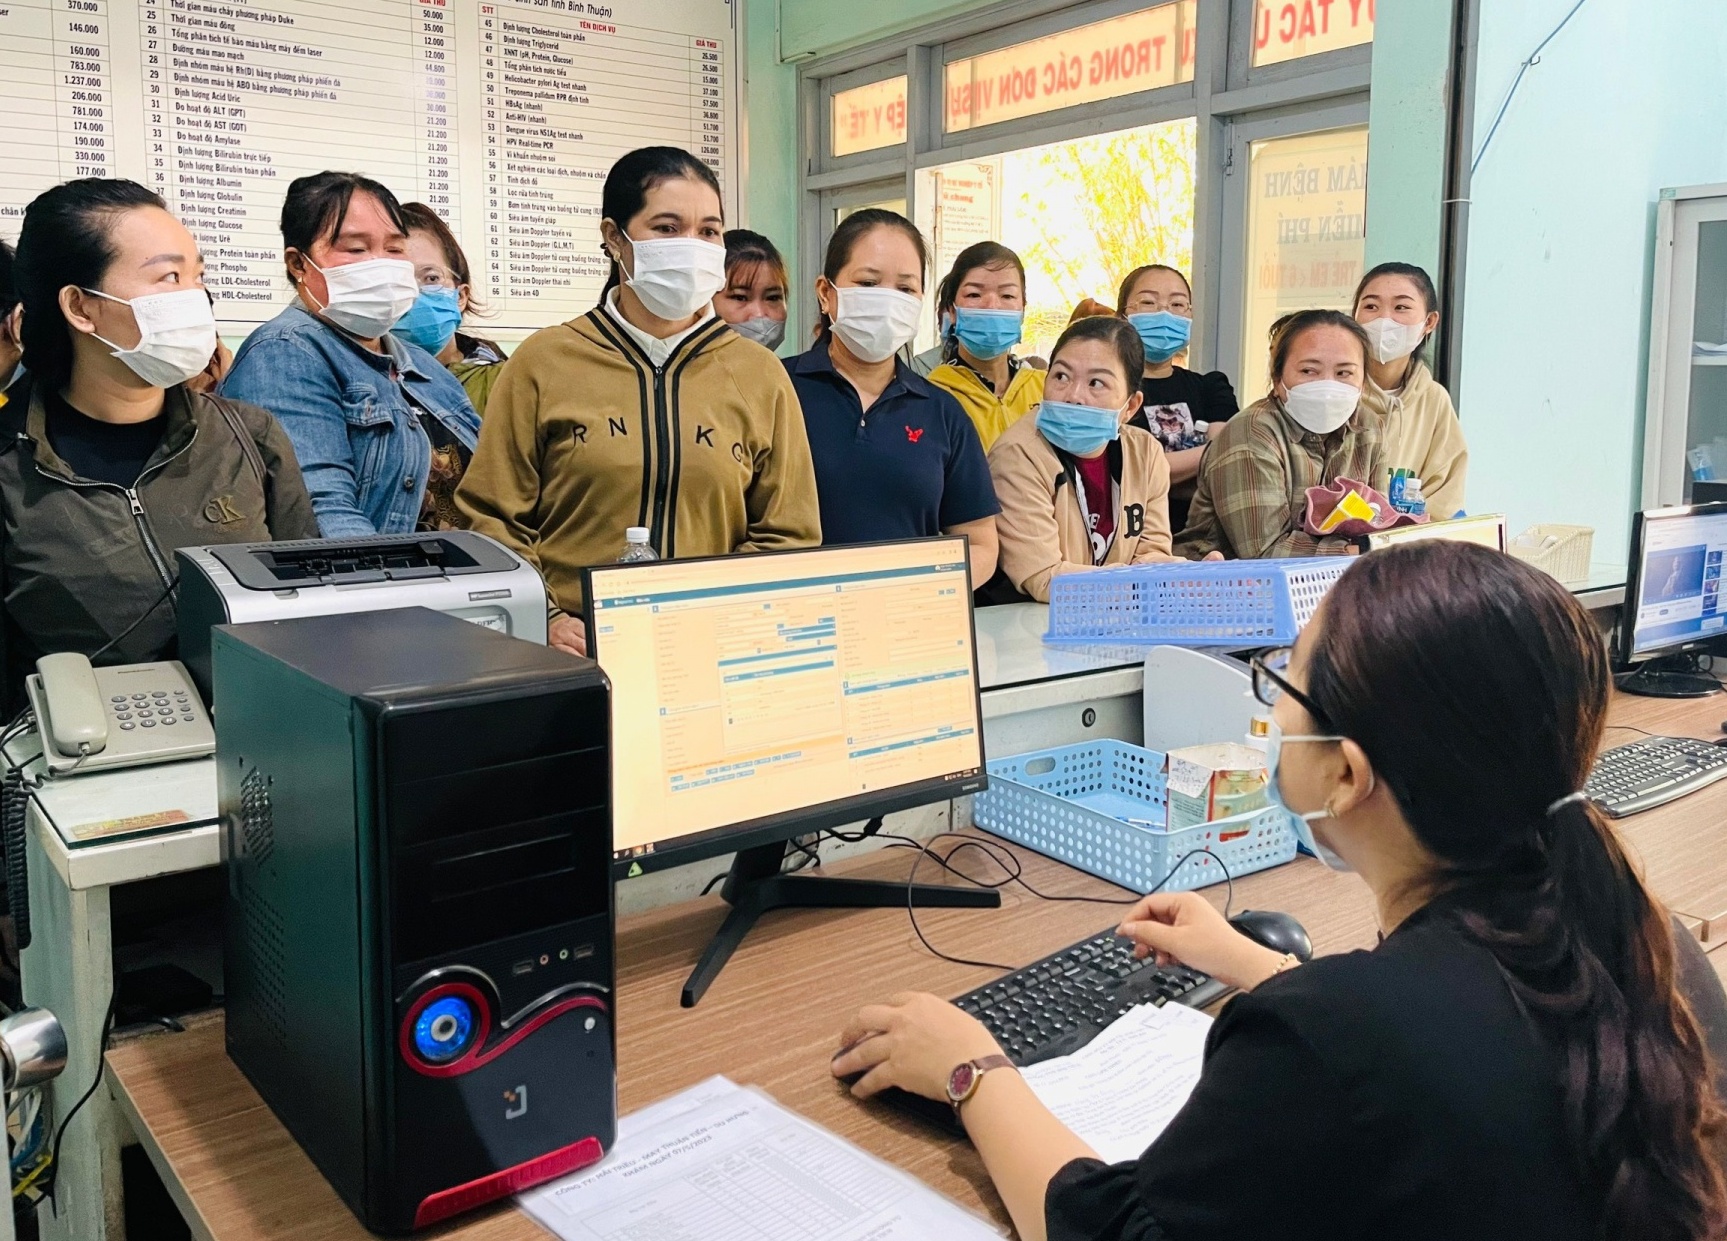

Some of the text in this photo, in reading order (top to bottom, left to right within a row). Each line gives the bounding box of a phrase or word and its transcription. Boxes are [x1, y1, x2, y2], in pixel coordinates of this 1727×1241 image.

[68, 0, 98, 12] 370.000
[481, 5, 494, 15] STT
[147, 10, 157, 20] 25
[188, 16, 201, 26] gian
[423, 9, 443, 20] 50.000
[278, 15, 294, 25] Duke
[580, 21, 591, 29] TÊN
[69, 22, 99, 34] 146.000
[147, 25, 157, 35] 26
[423, 23, 444, 33] 35.000
[484, 19, 560, 38] 45 Cholesterol
[148, 40, 157, 49] 27
[424, 36, 444, 47] 12.000
[485, 32, 559, 50] 46 Triglycerid
[70, 45, 100, 57] 160.000
[485, 45, 493, 53] 47
[149, 55, 158, 64] 28
[425, 50, 445, 60] 12.000
[70, 60, 101, 72] 783.000
[150, 69, 159, 79] 29
[486, 71, 536, 85] 49 Helicobacter
[65, 75, 102, 87] 1.237.000
[486, 84, 494, 92] 50
[72, 91, 102, 102] 206.000
[151, 84, 160, 94] 30
[212, 91, 226, 101] Acid
[227, 93, 241, 103] Uric
[487, 97, 494, 105] 51
[72, 106, 103, 117] 781.000
[151, 99, 160, 108] 31
[213, 106, 226, 115] ALT
[228, 108, 246, 118] (GPT)
[427, 116, 447, 126] 21.200
[487, 110, 495, 118] 52
[505, 112, 527, 122] Anti-HIV
[74, 121, 104, 132] 174.000
[152, 114, 247, 132] 32 AST (GOT)
[427, 129, 447, 139] 21.200
[488, 123, 539, 136] 53 Dengue virus
[74, 136, 105, 147] 190.000
[153, 128, 241, 146] 33 Amylase
[428, 142, 448, 152] 21.200
[488, 136, 554, 149] 54 HPV Real-time PCR
[75, 151, 105, 162] 330.000
[153, 143, 242, 160] 34 Bilirubin
[488, 148, 496, 156] 55
[154, 158, 164, 167] 35
[428, 156, 448, 165] 21.200
[489, 161, 496, 169] 56
[76, 166, 106, 177] 177.000
[428, 169, 448, 178] 21.200
[155, 172, 165, 181] 36
[216, 177, 242, 187] Albumin
[489, 174, 496, 182] 57
[429, 182, 449, 191] 21.200
[216, 191, 243, 202] Globulin
[429, 194, 449, 204] 21.200
[490, 199, 497, 207] 59
[217, 206, 247, 216] Creatinin
[490, 212, 498, 220] 60
[218, 220, 243, 230] Glucose
[490, 225, 498, 233] 61
[491, 237, 498, 245] 62
[219, 248, 243, 258] Protein
[491, 250, 499, 258] 63
[220, 262, 248, 272] Phospho
[221, 276, 271, 287] LDL-Cholesterol
[492, 275, 499, 283] 65
[221, 290, 272, 300] HDL-Cholesterol
[572, 424, 588, 448] R
[608, 416, 628, 437] N
[695, 425, 715, 448] K
[1124, 503, 1144, 539] B
